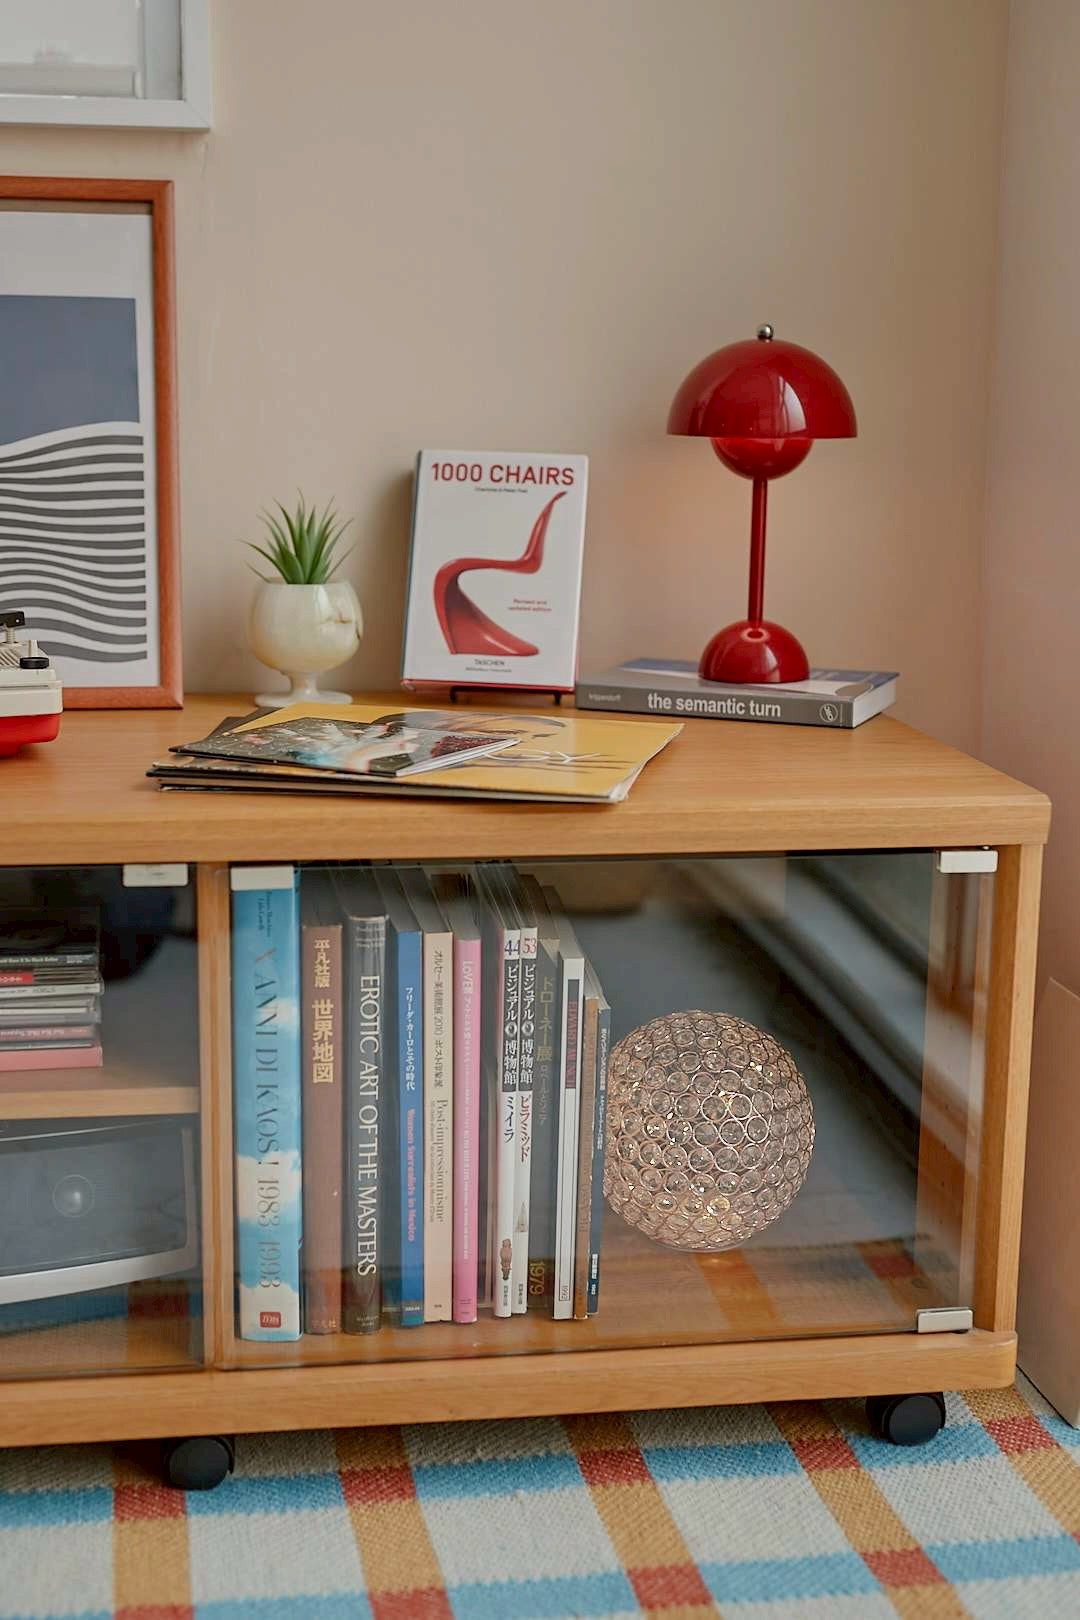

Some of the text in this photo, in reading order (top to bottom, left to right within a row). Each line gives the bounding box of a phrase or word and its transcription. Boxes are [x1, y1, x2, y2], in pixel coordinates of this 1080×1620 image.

[432, 463, 574, 486] 1000 CHAIRS
[647, 692, 781, 718] the semantic turn
[504, 939, 520, 956] 44
[522, 937, 537, 954] 53
[255, 972, 277, 1036] ANNI
[312, 939, 334, 1084] 平凡社版 世界地図
[503, 965, 518, 1085] ビジュアル 博物館
[520, 964, 535, 1085] ビジュアル 博物館
[255, 1048, 278, 1071] DI
[357, 975, 380, 1276] EROTIC ART OF THE MASTERS
[504, 1096, 515, 1143] ミイラ
[434, 1099, 448, 1223] Post-impressionnisme
[257, 1180, 281, 1228] 1983
[408, 1209, 417, 1242] Mexico
[529, 1261, 546, 1296] 1979
